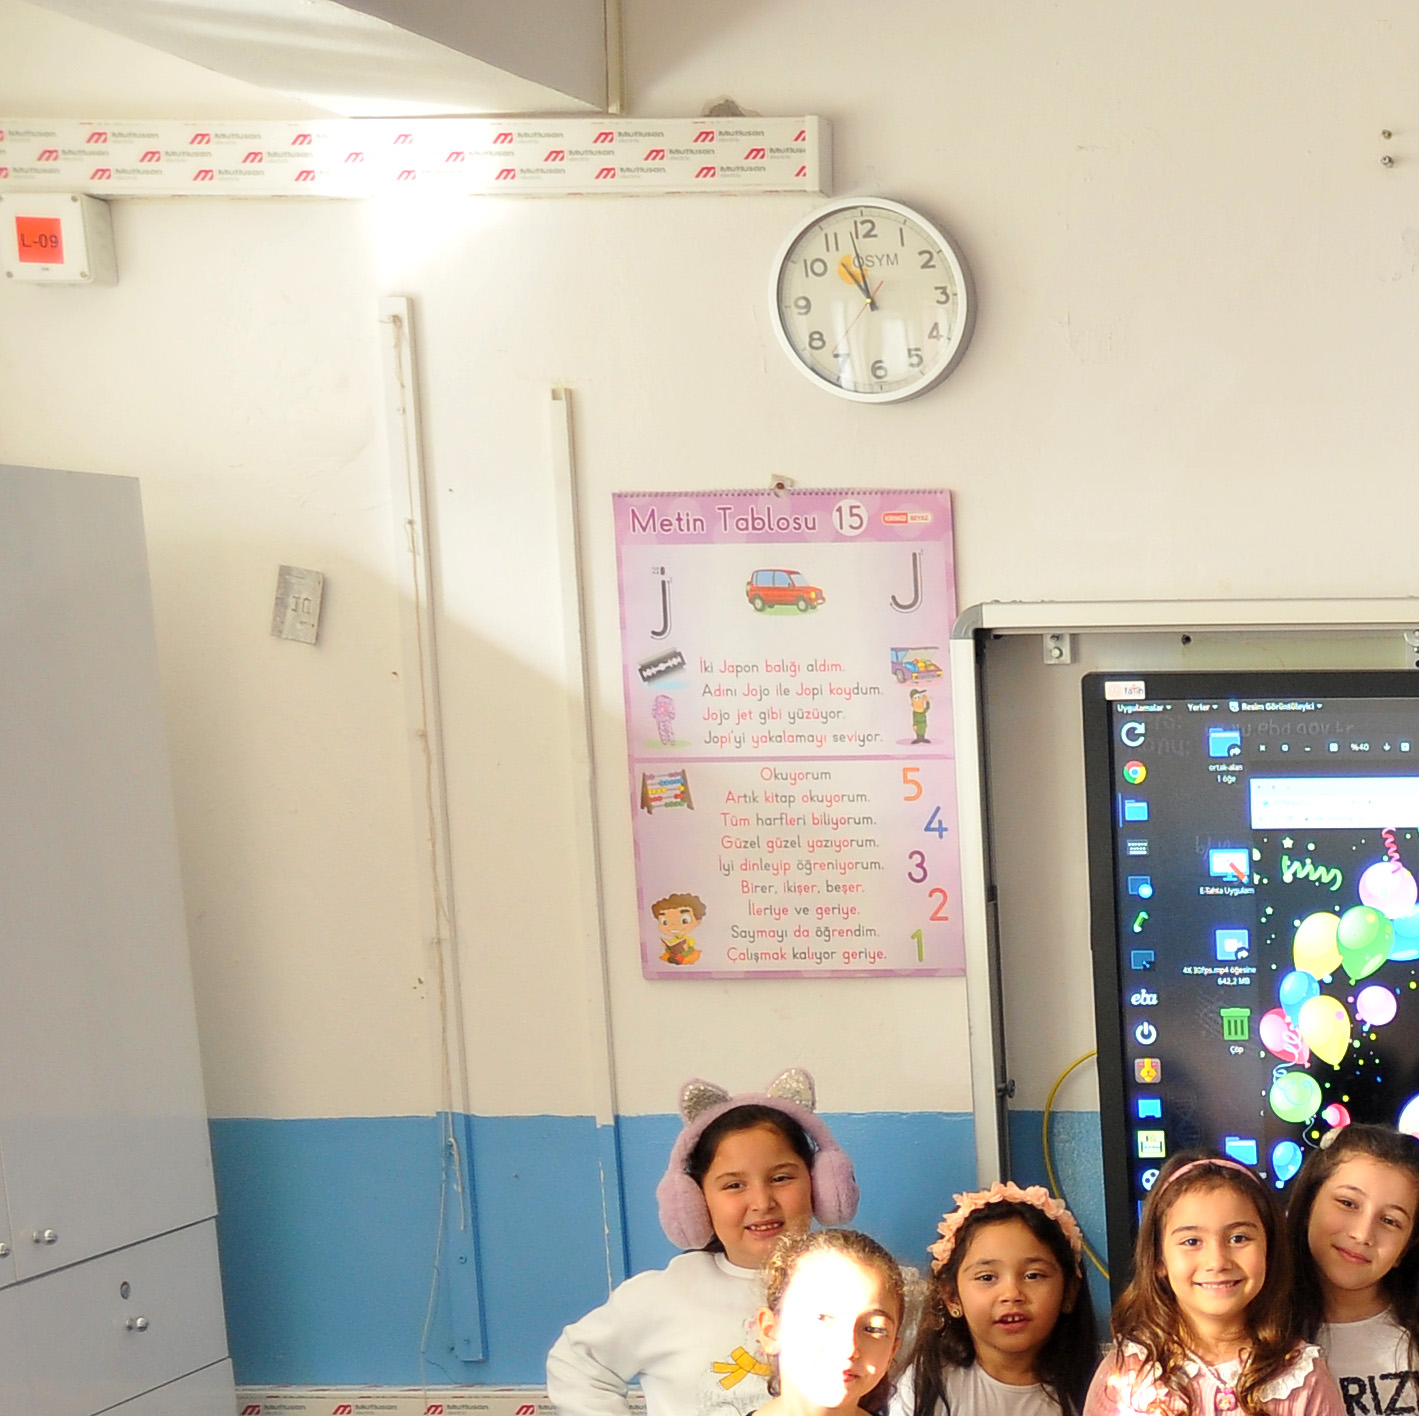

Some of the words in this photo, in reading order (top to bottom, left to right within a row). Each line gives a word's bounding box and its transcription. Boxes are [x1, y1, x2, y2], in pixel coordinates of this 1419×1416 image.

[854, 219, 878, 239] 12
[899, 227, 905, 247] 1
[21, 233, 59, 248] L-09
[825, 232, 839, 252] 11
[804, 258, 828, 278] 10
[918, 250, 936, 269] 2
[793, 296, 812, 315] 9
[934, 286, 950, 305] 3
[808, 331, 826, 351] 8
[928, 322, 943, 341] 4
[907, 347, 923, 368] 5
[871, 360, 888, 380] 6
[629, 507, 706, 535] Metin
[716, 506, 818, 533] Tablosu
[834, 505, 865, 531] 15
[700, 656, 713, 673] İki
[719, 659, 759, 678] Japon
[765, 659, 801, 677] balığı
[806, 659, 845, 673] aldım.
[702, 683, 737, 697] Adını
[742, 683, 770, 701] Jojo
[776, 683, 790, 697] ile
[796, 682, 823, 701] Jopi
[829, 682, 883, 701] koydum.
[703, 707, 730, 726] Jojo
[735, 707, 753, 726] jet
[759, 706, 782, 725] gibi
[788, 708, 845, 725] yüzüyor.
[1187, 702, 1210, 712] Yerler
[1241, 702, 1264, 711] Resim
[704, 730, 745, 749] Jopi'yi
[751, 730, 827, 749] yakalamayı
[833, 731, 883, 747] seviyor.
[760, 766, 831, 786] Okuyorum
[902, 767, 923, 802] 5
[725, 790, 759, 804] Artık
[764, 790, 796, 808] kitap
[801, 790, 870, 808] okuyorum.
[720, 812, 750, 827] Tüm
[756, 812, 806, 827] harfleri
[811, 812, 876, 831] biliyorum.
[923, 805, 949, 839] 4
[721, 835, 761, 849] Güzel
[766, 835, 802, 853] güzel
[807, 837, 879, 853] yazıyorum.
[718, 855, 734, 876] İyi
[740, 857, 791, 876] dinleyip
[796, 858, 884, 876] öğreniyorum.
[907, 850, 928, 883] 3
[741, 880, 778, 895] Birer,
[783, 880, 821, 895] ikişer,
[826, 880, 864, 896] beşer.
[748, 899, 789, 921] İleriye
[794, 906, 810, 916] ve
[815, 904, 860, 921] geriye.
[928, 887, 949, 921] 2
[730, 925, 788, 944] Saymayı
[793, 925, 810, 939] da
[815, 924, 880, 942] öğrendim.
[910, 928, 924, 963] 1
[727, 947, 787, 964] Çalışmak
[792, 947, 836, 965] kalıyor
[842, 948, 887, 964] geriye.
[1130, 989, 1158, 1006] eba
